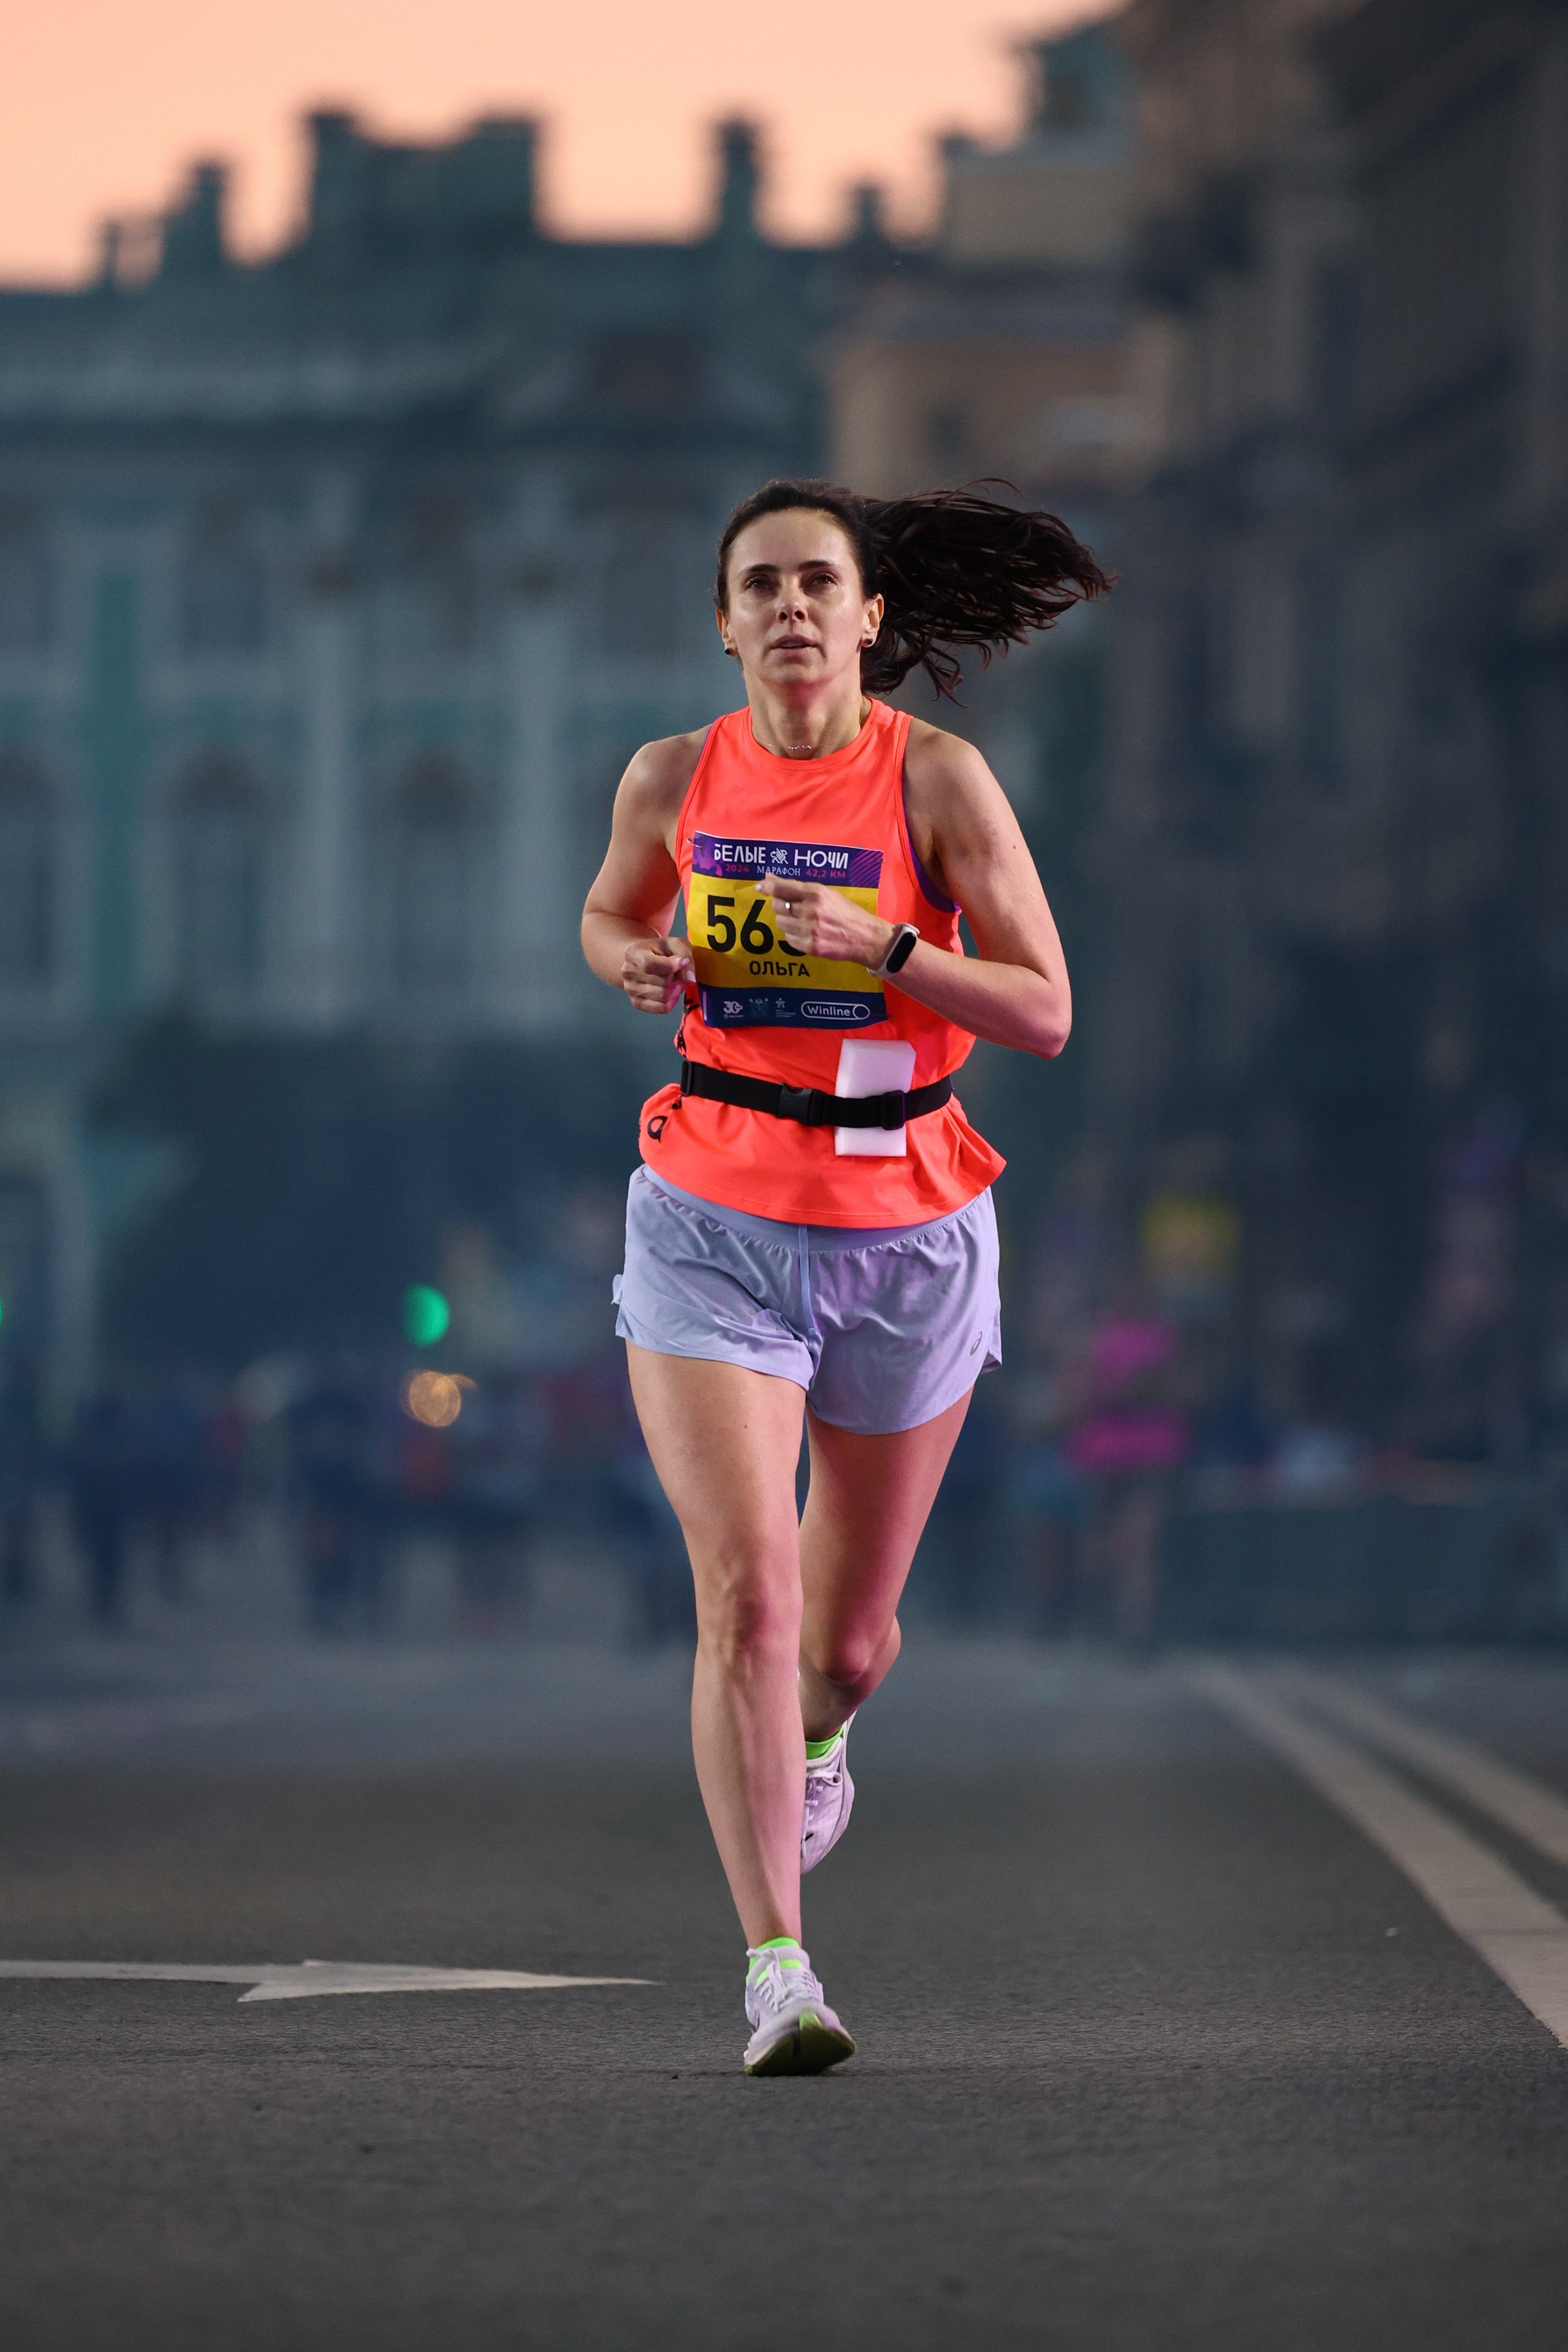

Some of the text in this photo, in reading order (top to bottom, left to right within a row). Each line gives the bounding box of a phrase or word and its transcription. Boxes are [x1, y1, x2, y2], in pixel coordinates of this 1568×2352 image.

[714, 843, 848, 869] БЕЛЫЕ НОЧИ
[725, 864, 750, 874] 2024
[757, 866, 801, 876] МАРАФОН
[806, 869, 827, 879] 42,2
[749, 960, 810, 977] ОЛЬГА
[807, 1004, 851, 1017] Winline
